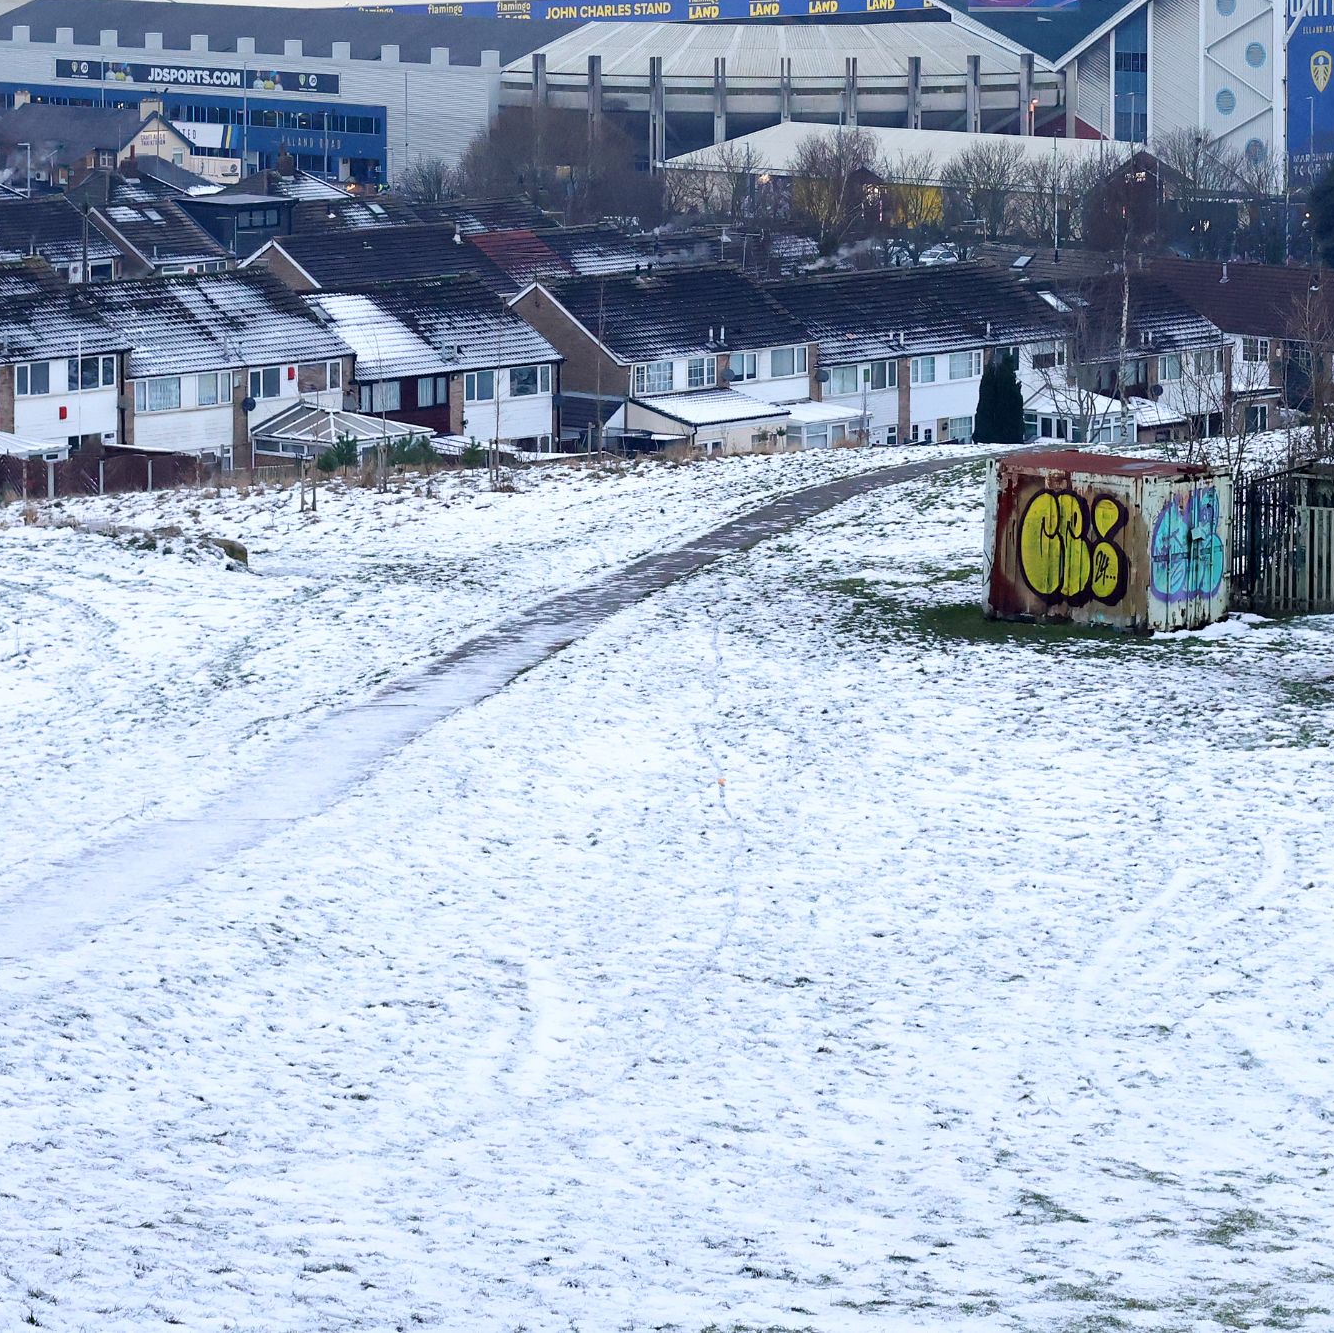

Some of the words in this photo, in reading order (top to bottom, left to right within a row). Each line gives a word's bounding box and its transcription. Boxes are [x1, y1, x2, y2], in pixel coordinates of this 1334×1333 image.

[427, 2, 463, 16] flamingo
[496, 0, 531, 13] flamingo
[545, 6, 578, 20] JOHN
[580, 4, 632, 18] CHARLES
[634, 2, 671, 16] STAND
[688, 6, 720, 19] LAND
[749, 2, 780, 17] LAND
[808, 0, 838, 14] LAND
[147, 67, 241, 86] JDSPORTS.COM
